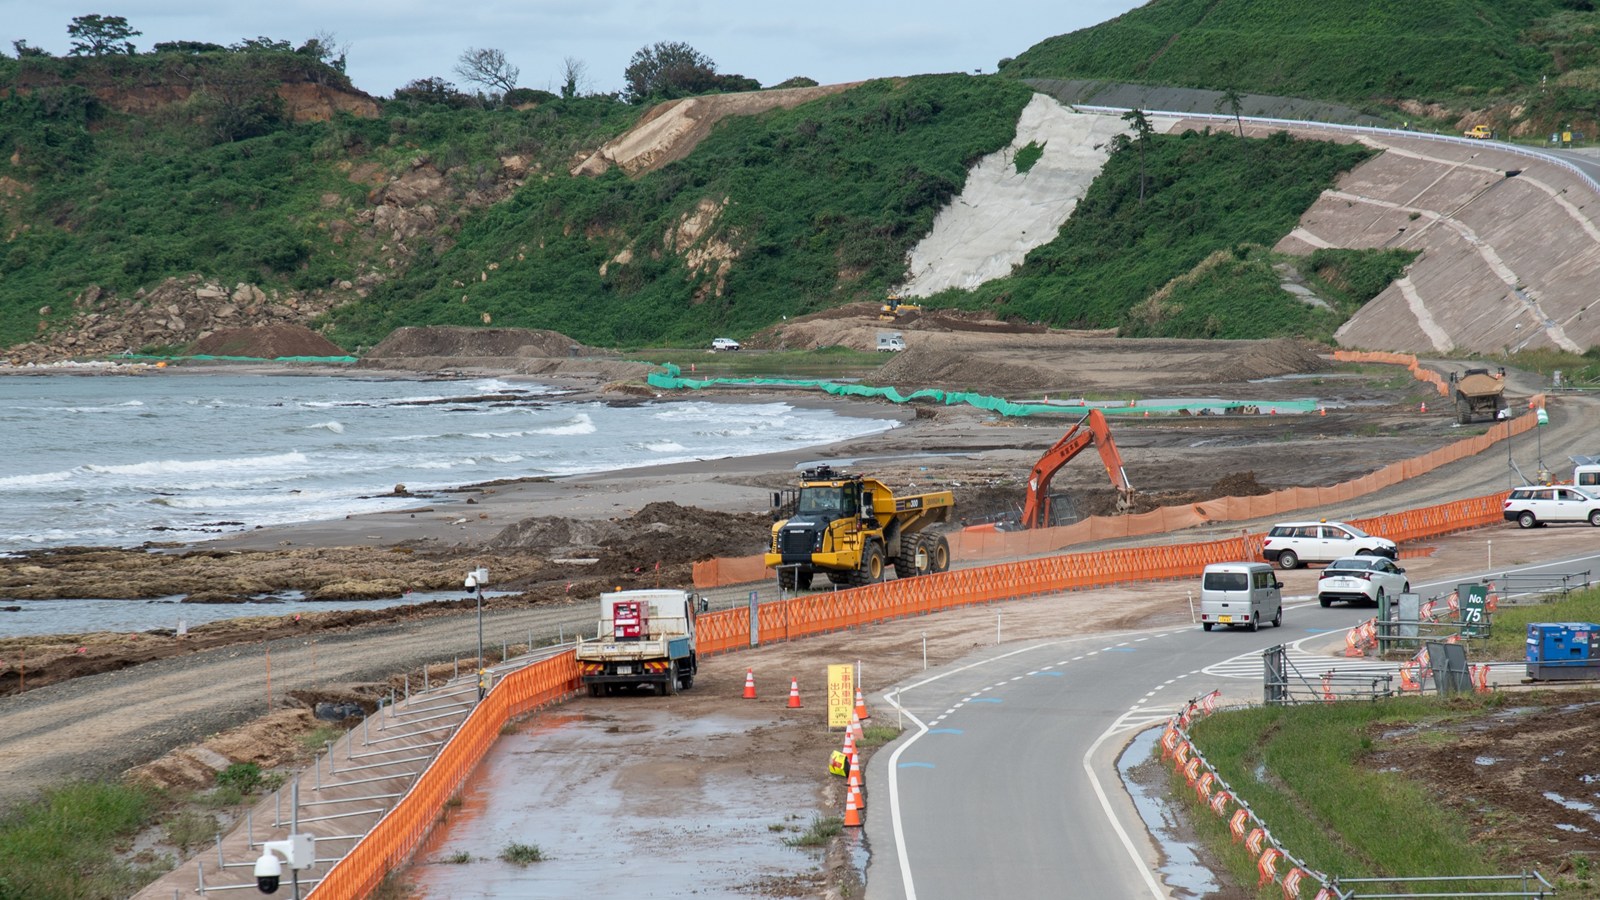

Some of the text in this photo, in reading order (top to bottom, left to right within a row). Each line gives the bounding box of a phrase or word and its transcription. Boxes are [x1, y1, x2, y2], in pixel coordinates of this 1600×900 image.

[1468, 594, 1484, 604] No.
[1466, 607, 1482, 622] 75
[830, 683, 840, 706] 出入口
[841, 666, 851, 706] 工事用車両
